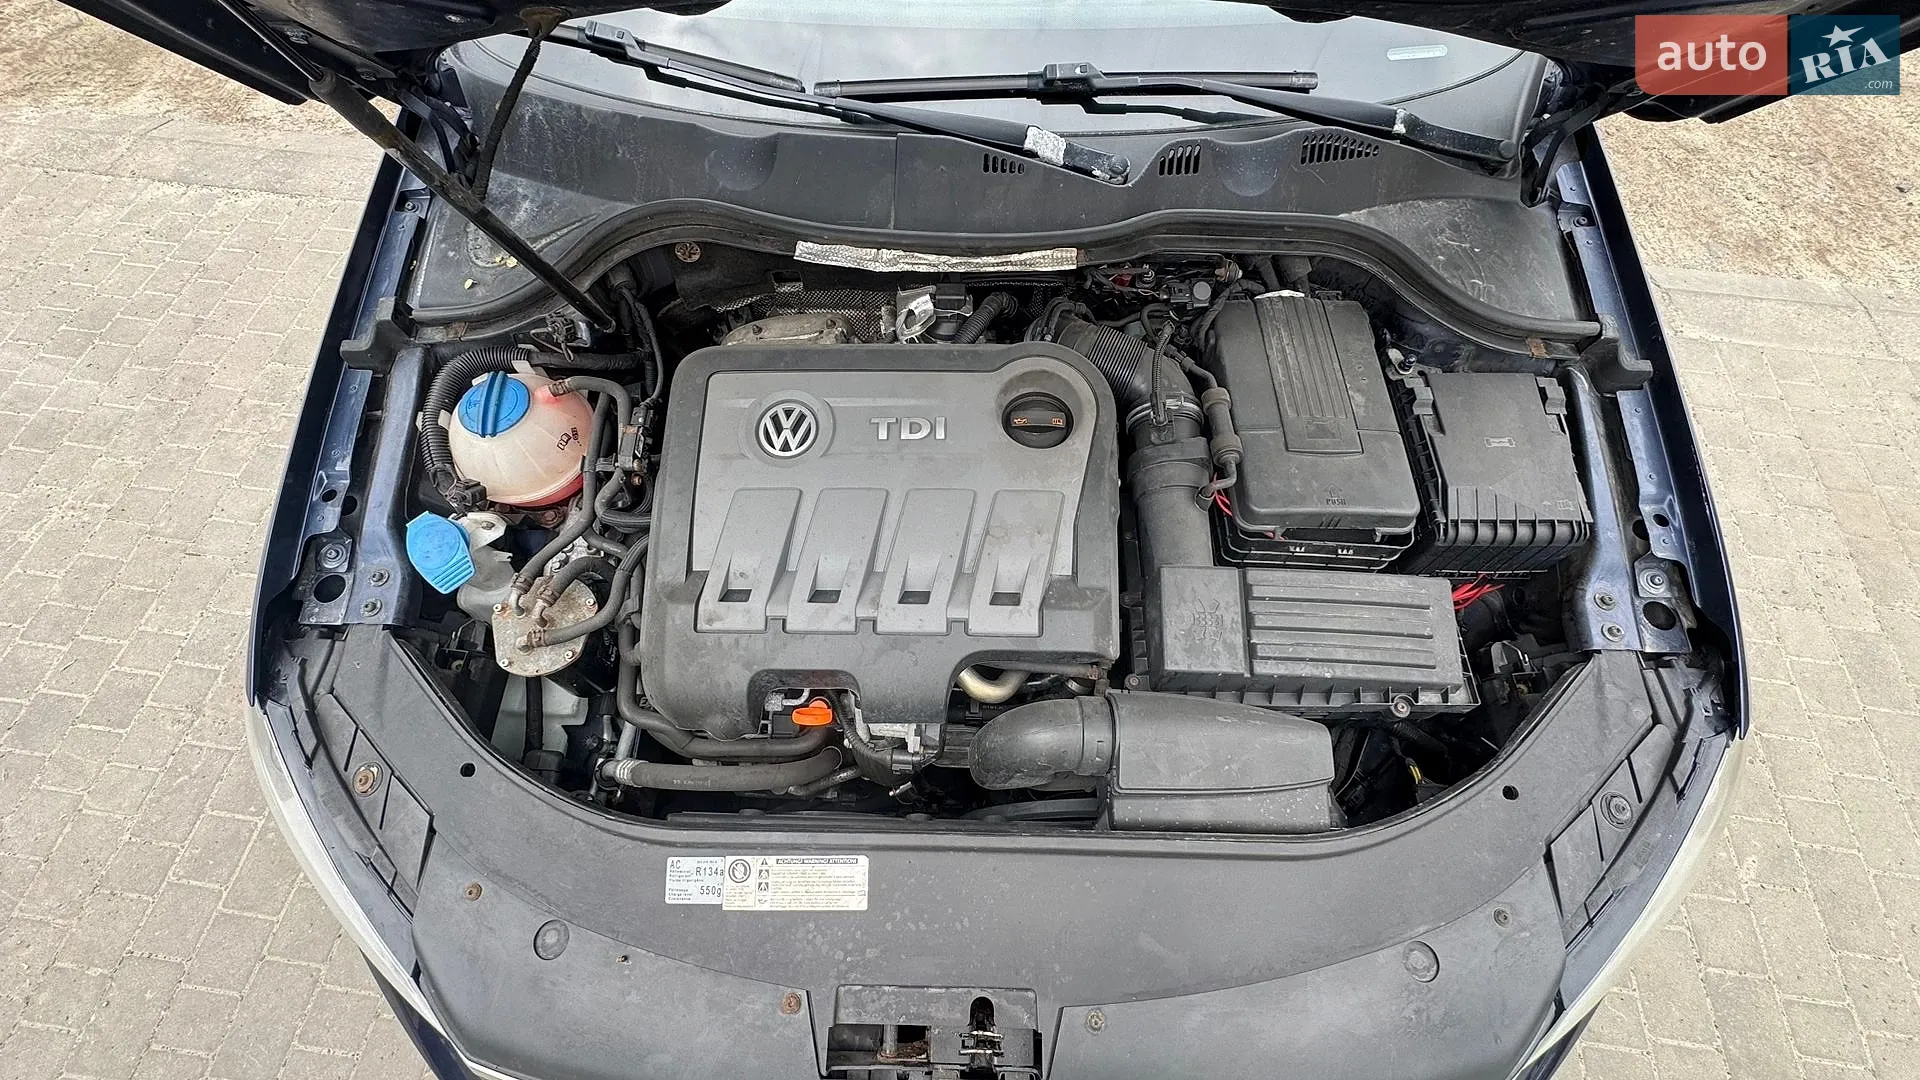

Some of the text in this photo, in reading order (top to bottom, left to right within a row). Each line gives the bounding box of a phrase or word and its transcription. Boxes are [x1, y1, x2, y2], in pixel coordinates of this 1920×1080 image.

[758, 402, 817, 457] VW
[870, 416, 946, 441] TDI
[669, 859, 681, 870] AC
[695, 866, 724, 877] R134a
[699, 885, 722, 898] 550g
